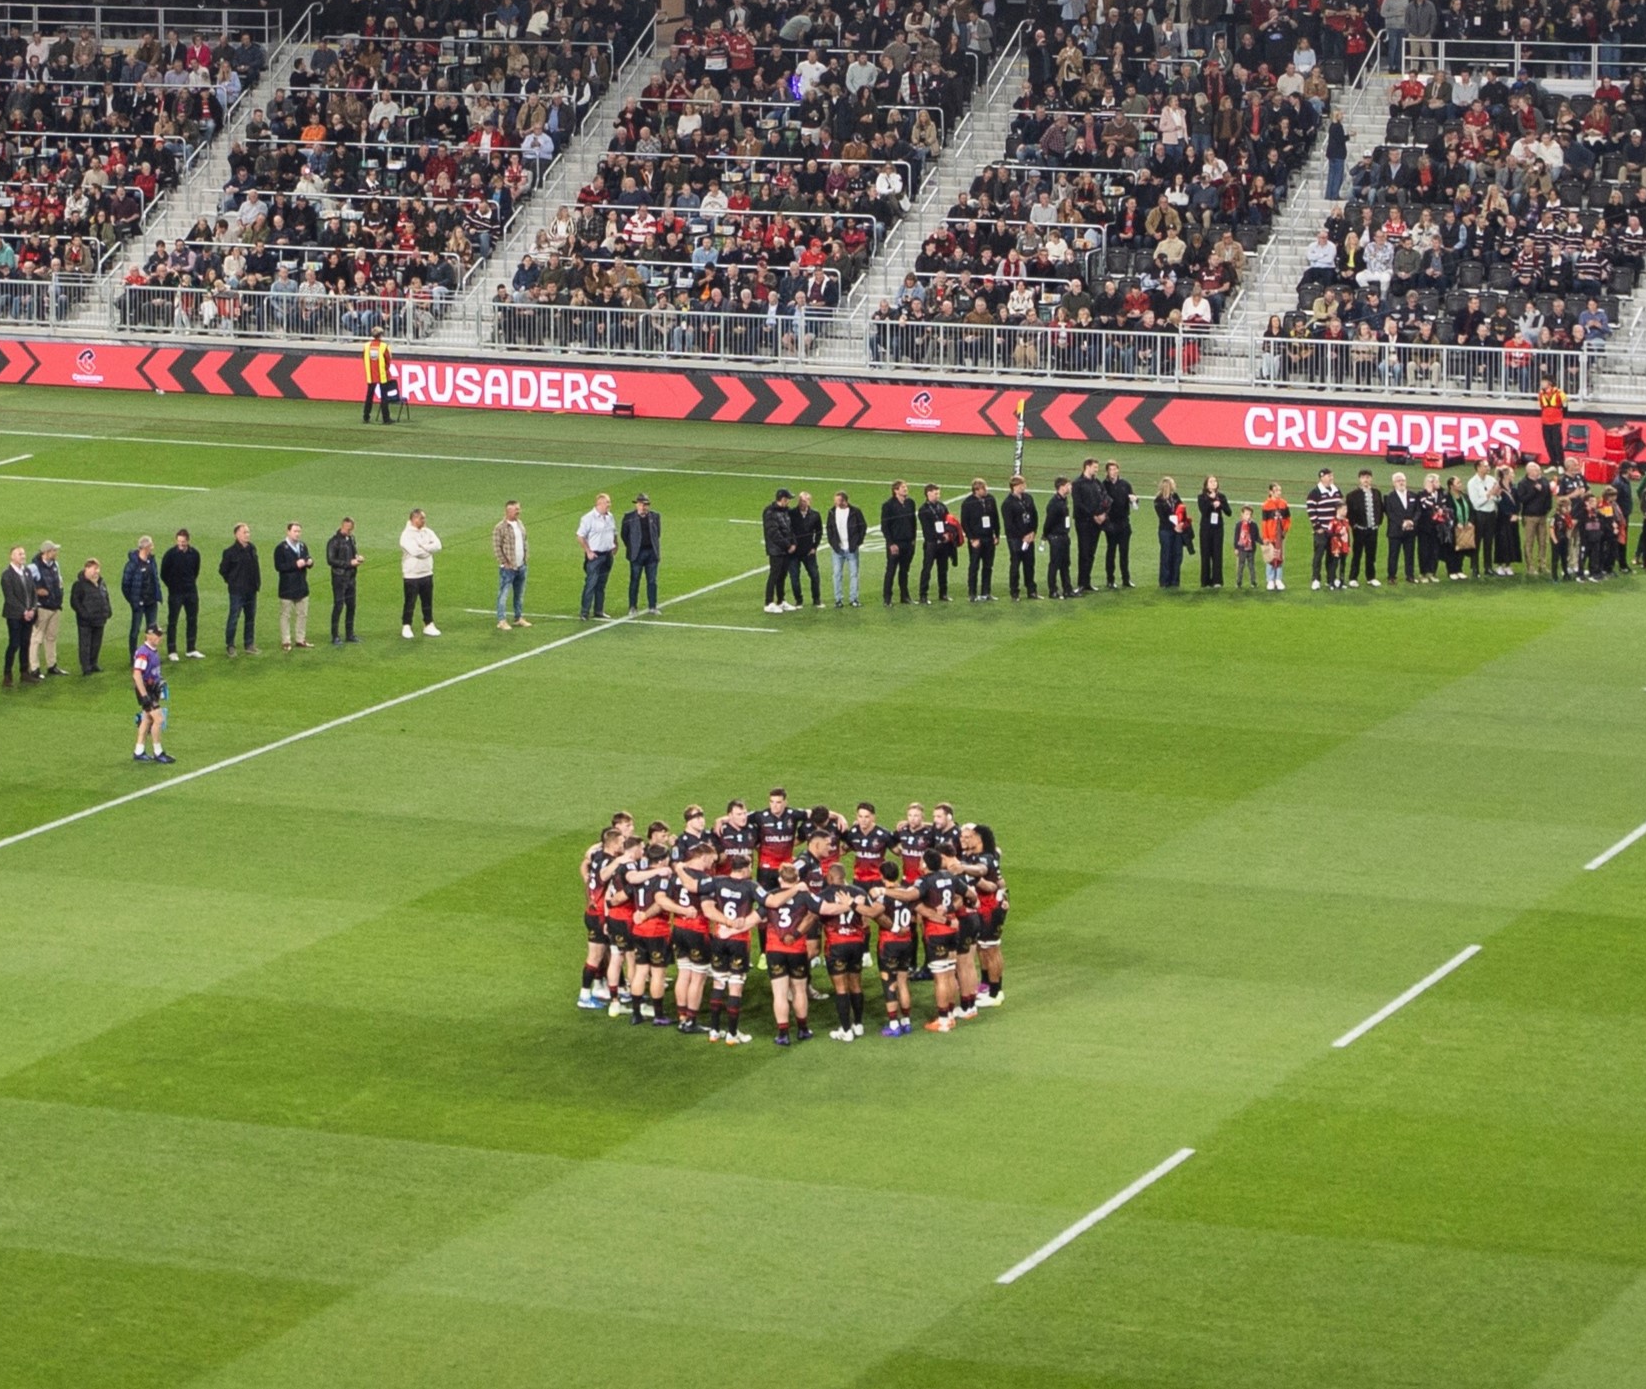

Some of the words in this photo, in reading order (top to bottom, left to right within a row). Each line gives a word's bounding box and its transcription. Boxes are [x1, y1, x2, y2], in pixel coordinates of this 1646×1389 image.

[1244, 407, 1522, 457] CRUSADERS
[638, 888, 645, 907] 1
[679, 888, 690, 907] 5
[942, 888, 952, 907] 8
[723, 901, 738, 920] 6
[778, 907, 793, 928] 3
[893, 908, 911, 929] 10
